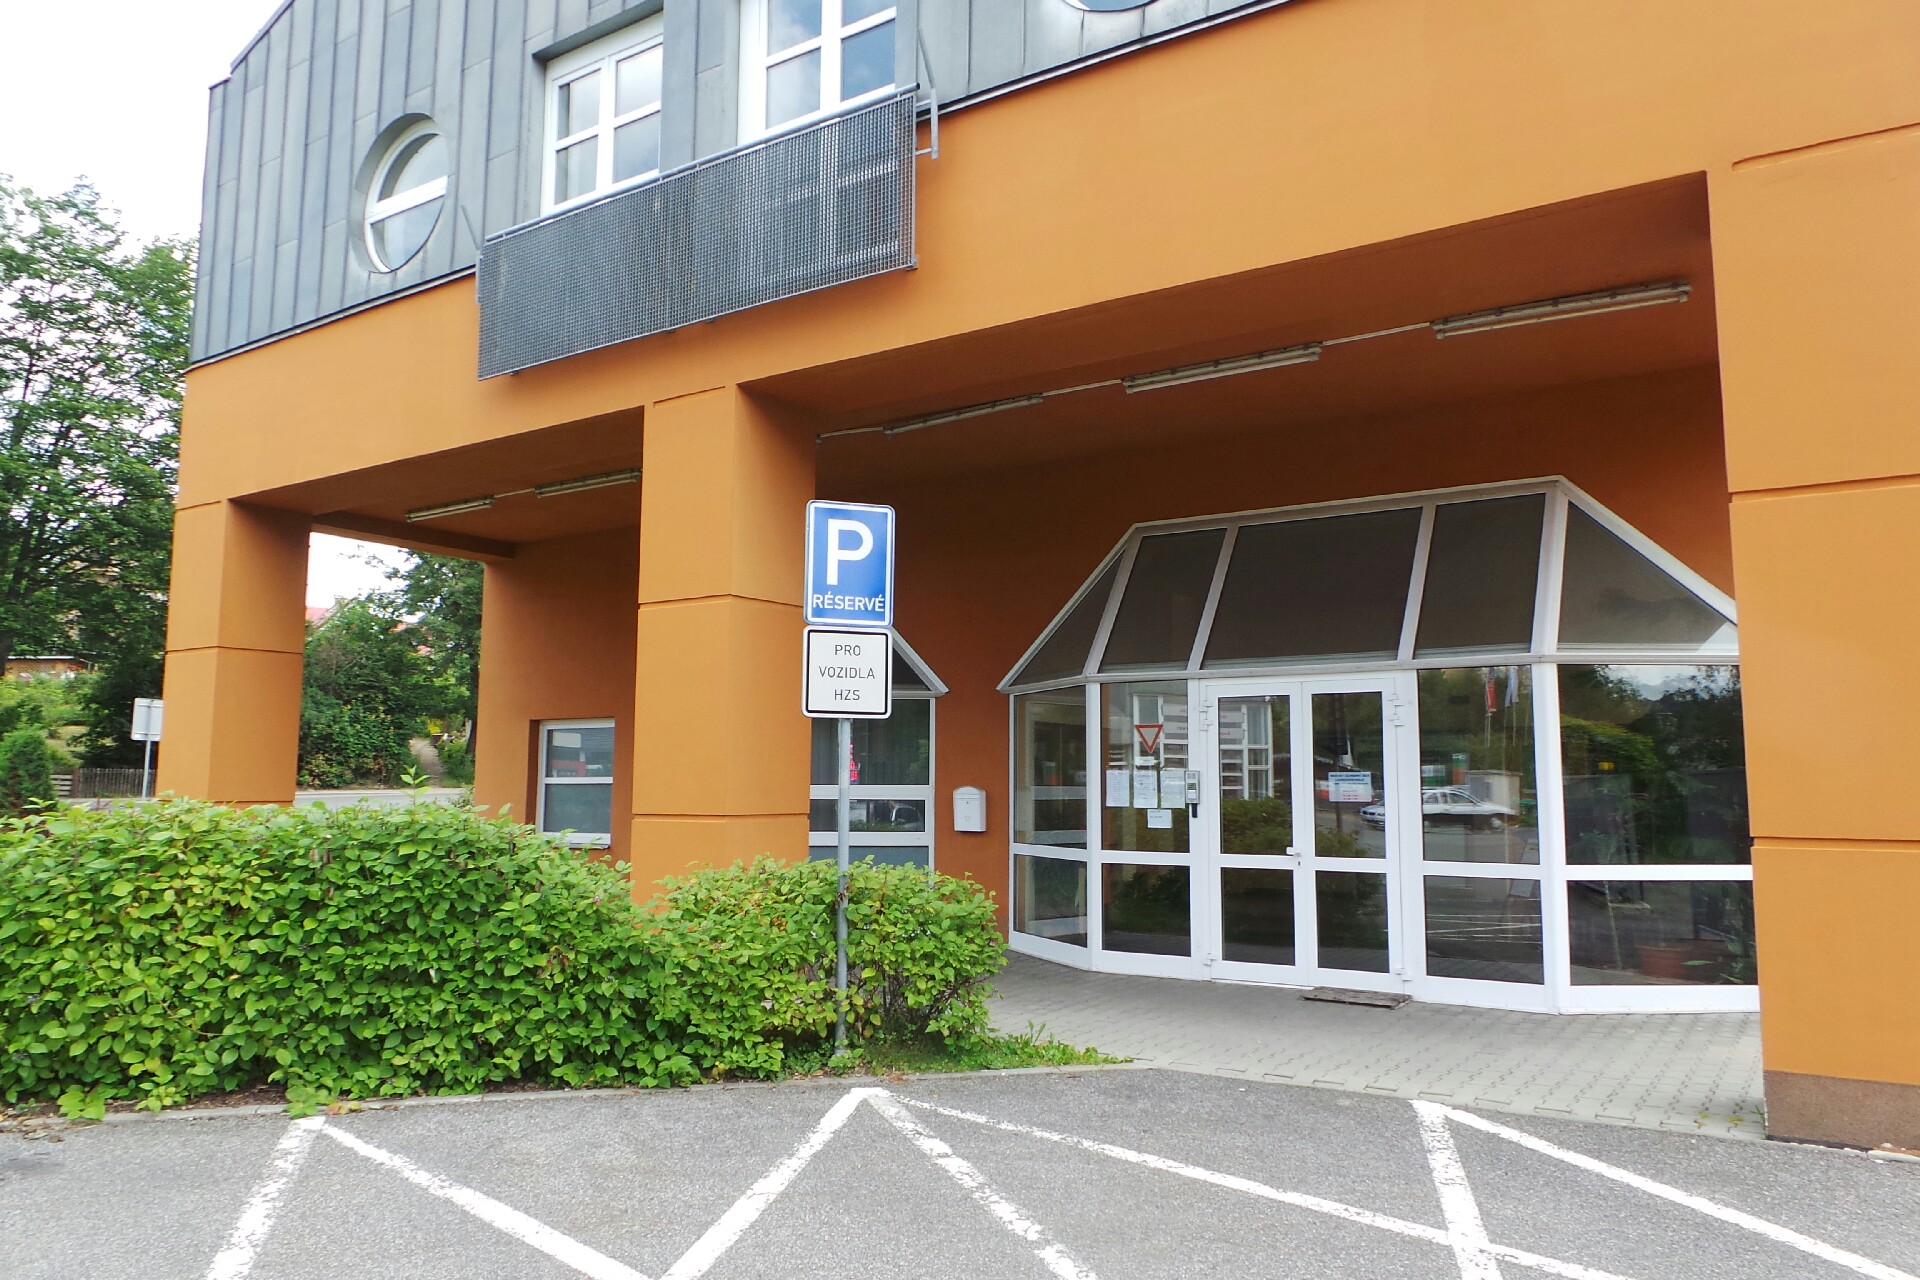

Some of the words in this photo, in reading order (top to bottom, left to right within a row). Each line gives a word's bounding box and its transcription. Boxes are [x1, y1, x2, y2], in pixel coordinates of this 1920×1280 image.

[826, 518, 874, 586] P
[812, 591, 885, 612] RÉSERVÉ
[834, 644, 861, 656] PRO
[818, 665, 876, 679] VOZIDLA
[833, 688, 861, 701] HZS
